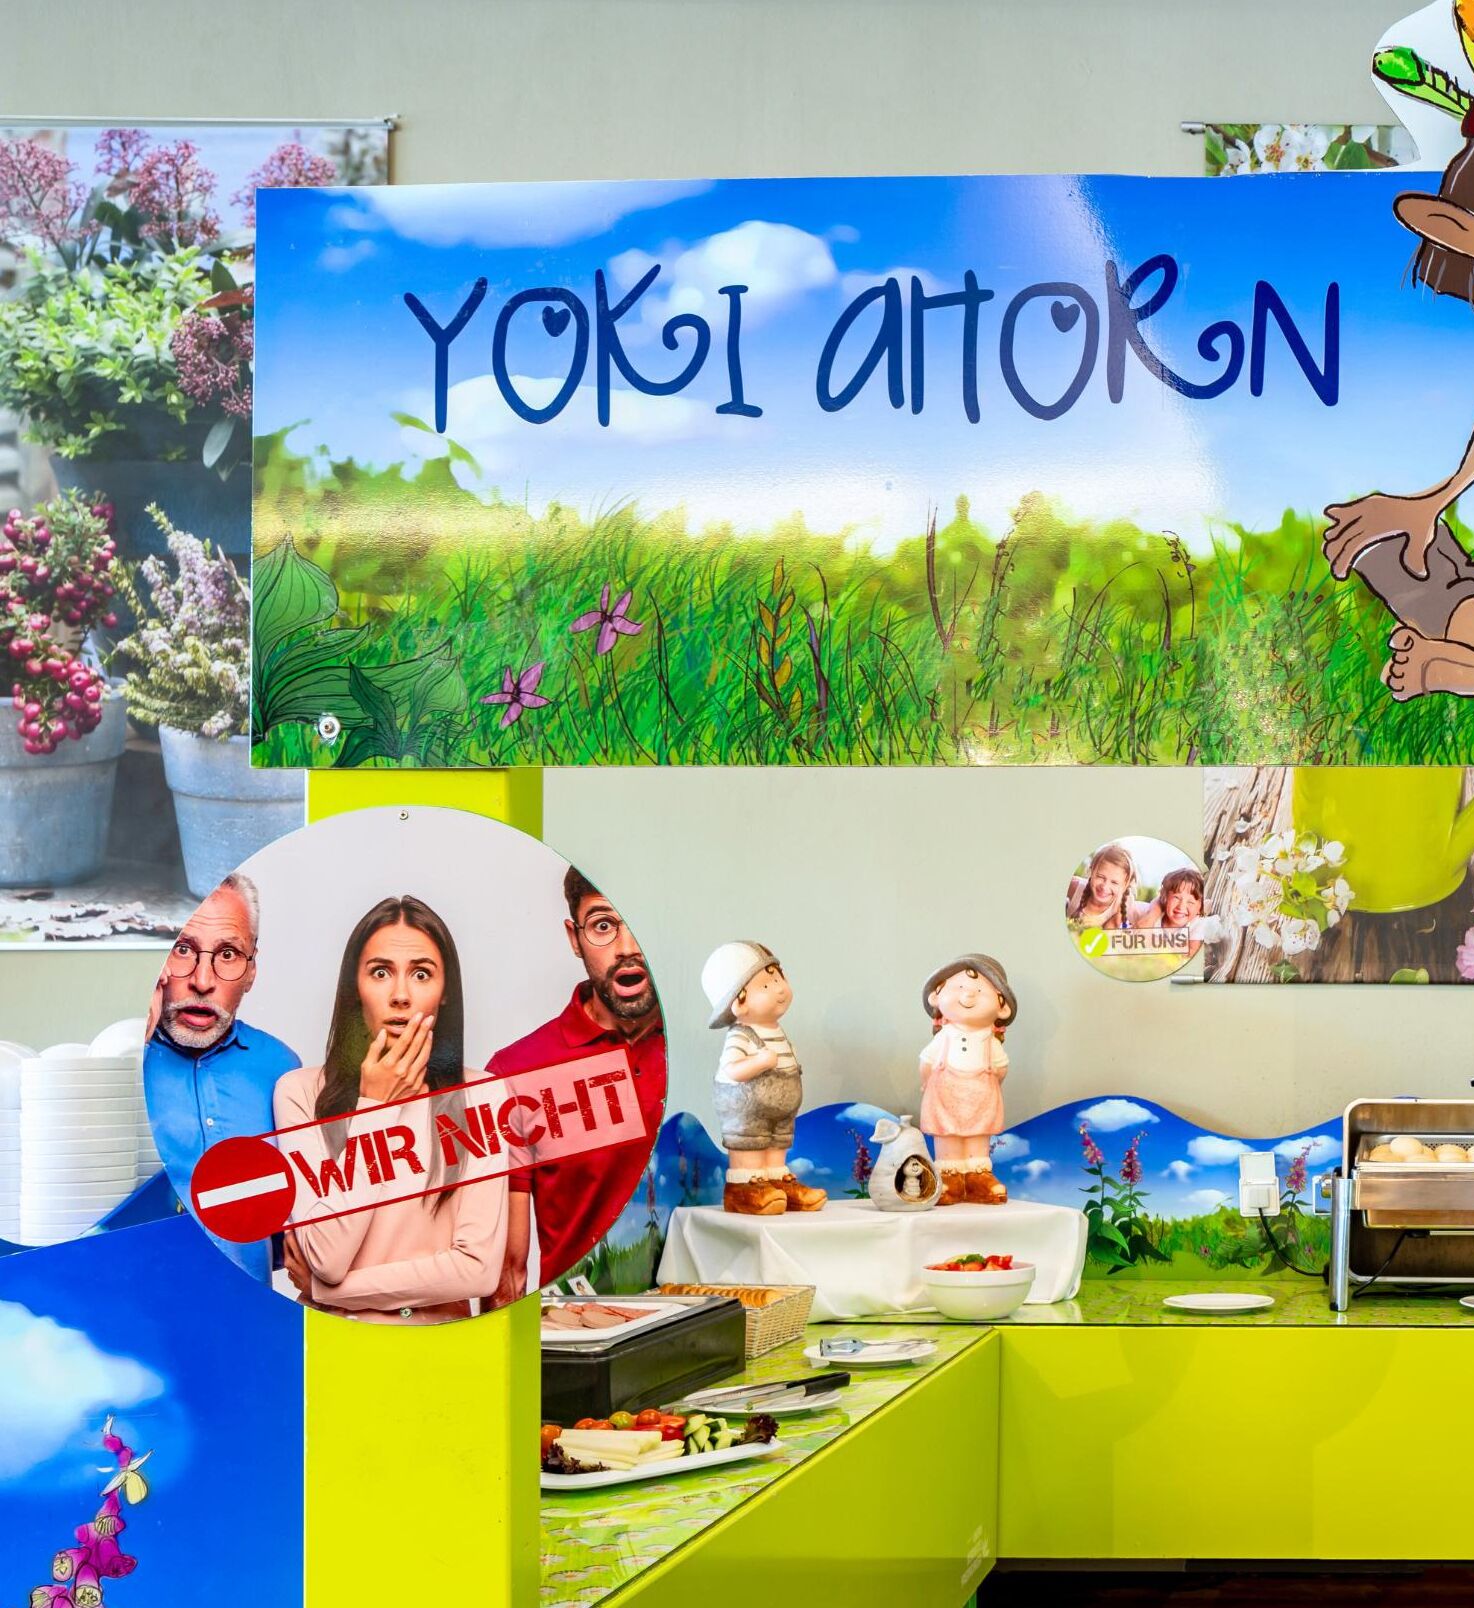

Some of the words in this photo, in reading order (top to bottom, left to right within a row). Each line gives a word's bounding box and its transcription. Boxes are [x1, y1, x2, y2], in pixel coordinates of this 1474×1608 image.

[403, 263, 763, 434] YOKI
[1111, 930, 1146, 949] FÜR
[1152, 933, 1187, 949] UNS
[288, 1124, 426, 1199] WIR
[434, 1068, 627, 1167] NICHT
